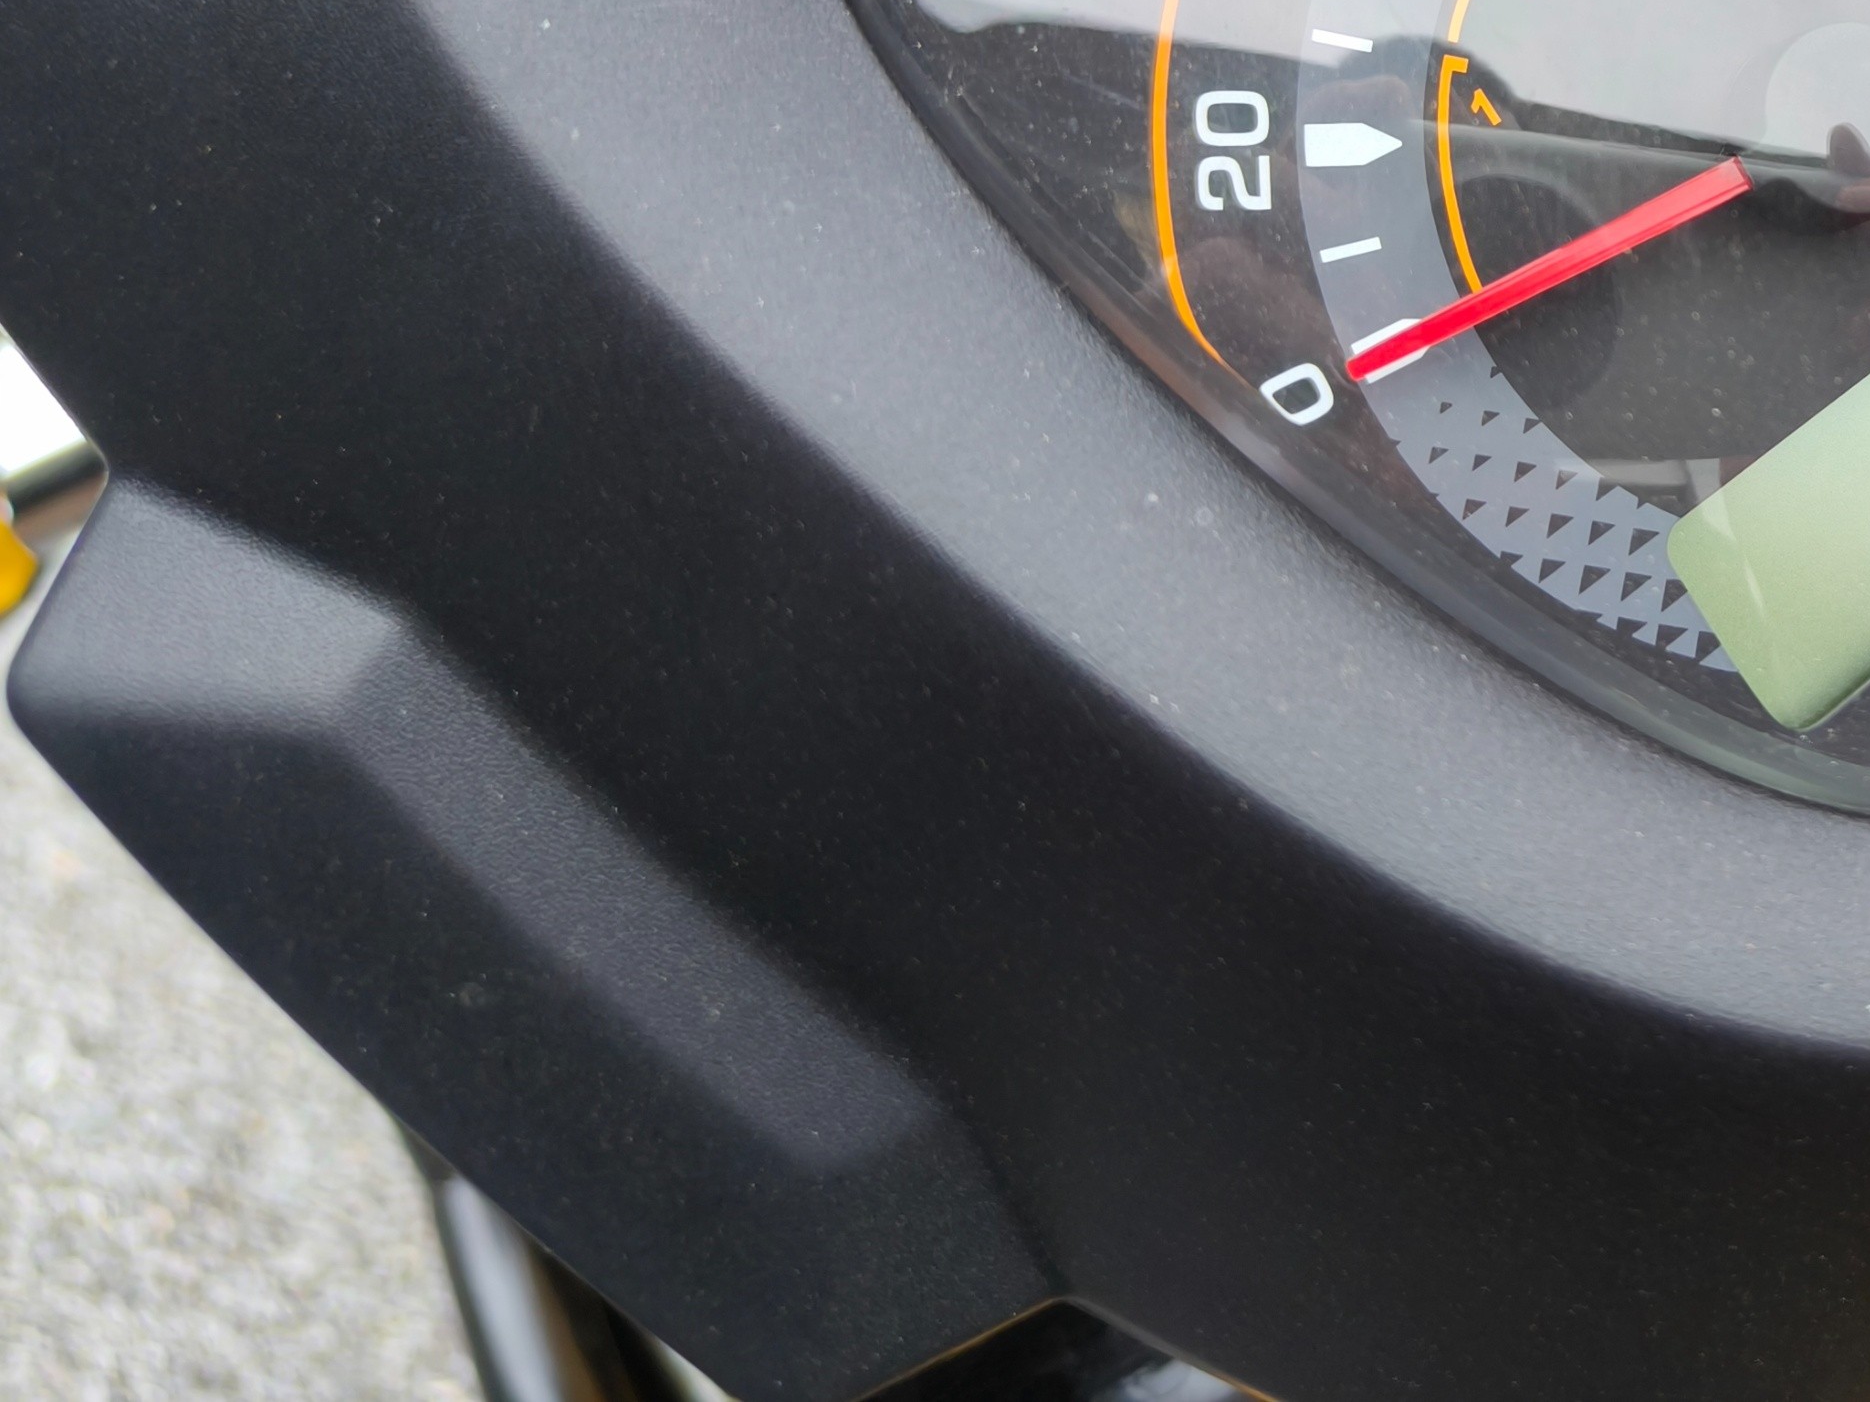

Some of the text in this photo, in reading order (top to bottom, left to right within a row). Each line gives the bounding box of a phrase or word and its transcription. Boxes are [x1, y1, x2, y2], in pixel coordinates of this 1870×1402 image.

[1470, 88, 1502, 126] 1
[1195, 90, 1272, 211] 20
[1259, 362, 1334, 426] 0
